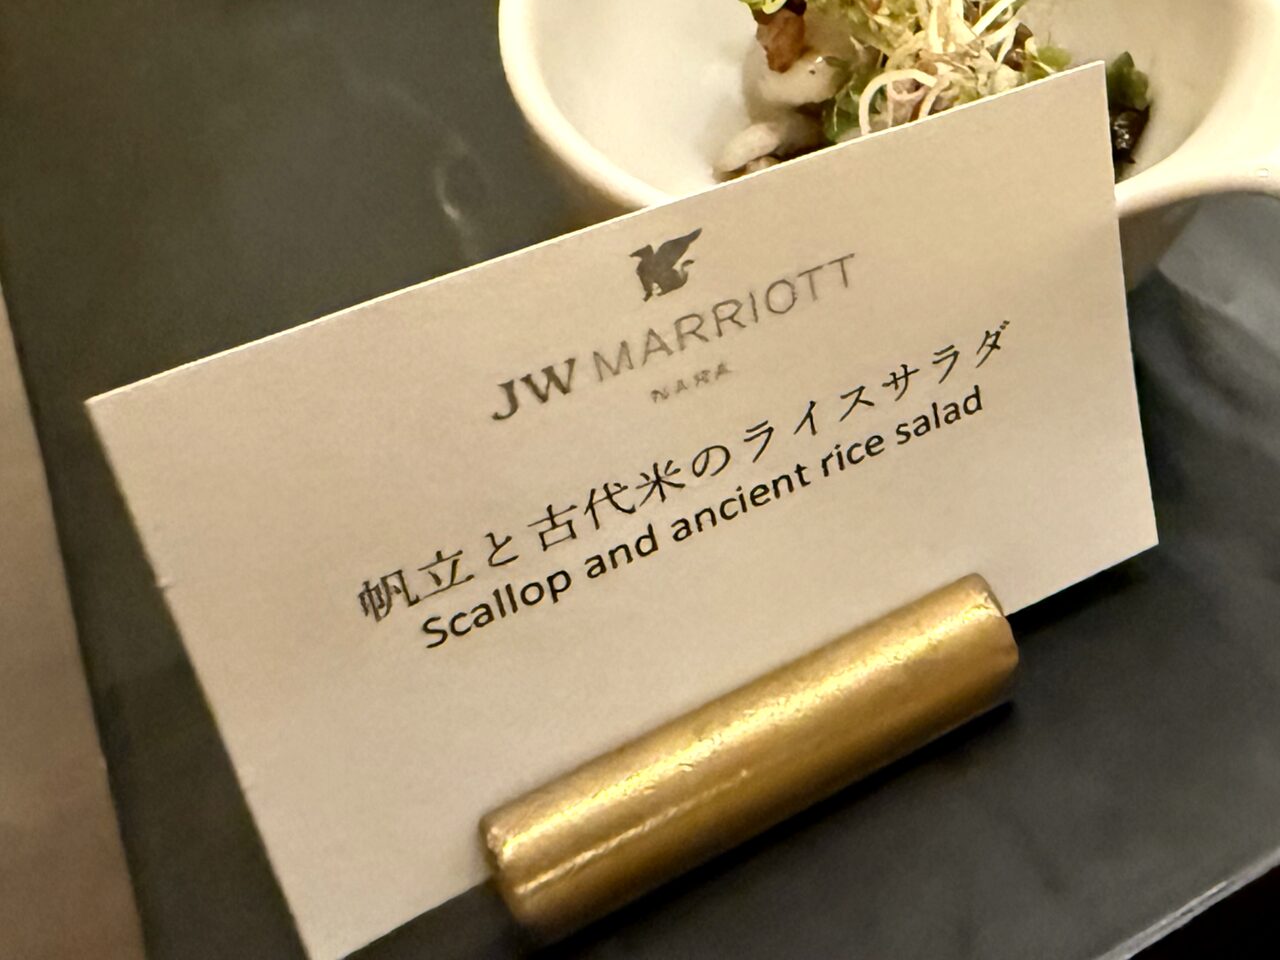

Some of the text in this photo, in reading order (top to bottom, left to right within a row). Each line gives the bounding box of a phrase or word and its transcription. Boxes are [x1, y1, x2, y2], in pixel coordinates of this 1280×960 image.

[492, 253, 858, 421] JW MARRIOTT
[650, 362, 732, 404] NARA
[357, 320, 1011, 622] 帆立と古代米のライスサラダ
[422, 386, 983, 649] Scallop and ancient rice salad
